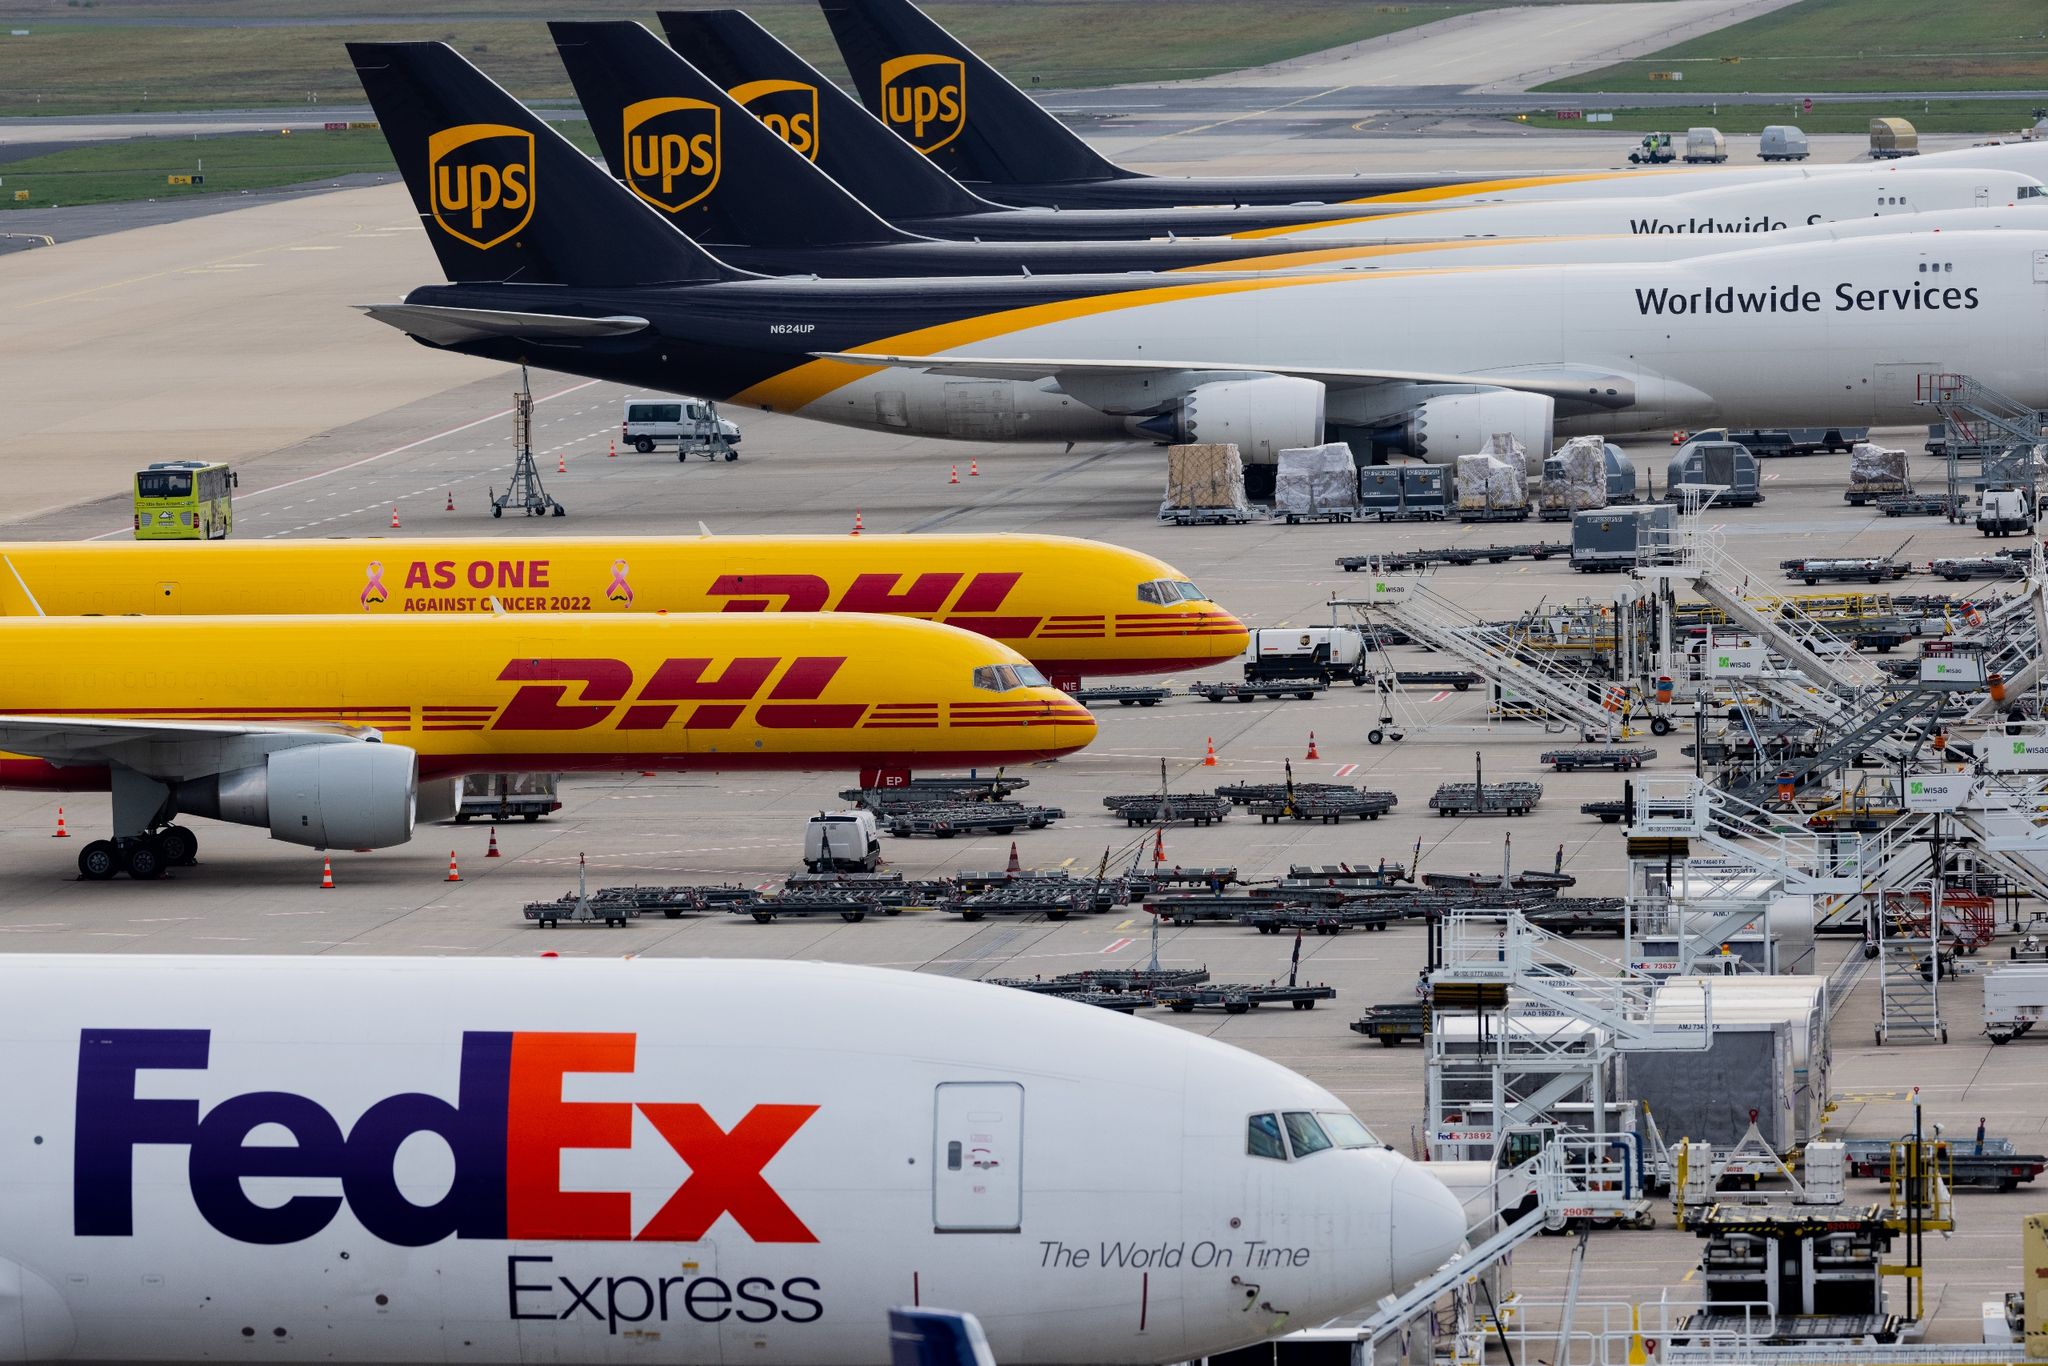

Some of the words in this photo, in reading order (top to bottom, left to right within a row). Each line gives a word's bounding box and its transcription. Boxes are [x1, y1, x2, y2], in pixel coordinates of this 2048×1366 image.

[888, 85, 960, 138] ups
[755, 112, 813, 153] ps
[632, 133, 714, 194] ups
[438, 163, 527, 229] ups
[1635, 284, 1821, 315] Worldwide
[1835, 280, 1980, 312] Services
[770, 324, 816, 334] N624UP
[404, 561, 456, 589] AS
[467, 560, 549, 589] ONE
[404, 598, 477, 612] AGAINST
[550, 597, 592, 611] 2022
[705, 572, 1044, 639] DHL
[490, 656, 870, 730] DHL
[1062, 682, 1077, 691] NE
[886, 776, 903, 786] EP
[1630, 962, 1650, 970] FedEx
[1654, 962, 1677, 970] 73637
[74, 1028, 822, 1248] FedEx
[1437, 1132, 1461, 1140] FedEx
[1463, 1132, 1492, 1140] 73892
[1039, 1240, 1090, 1268] The
[1100, 1240, 1185, 1268] World
[1191, 1240, 1233, 1268] On
[1244, 1240, 1310, 1268] Time
[507, 1255, 824, 1336] Express
